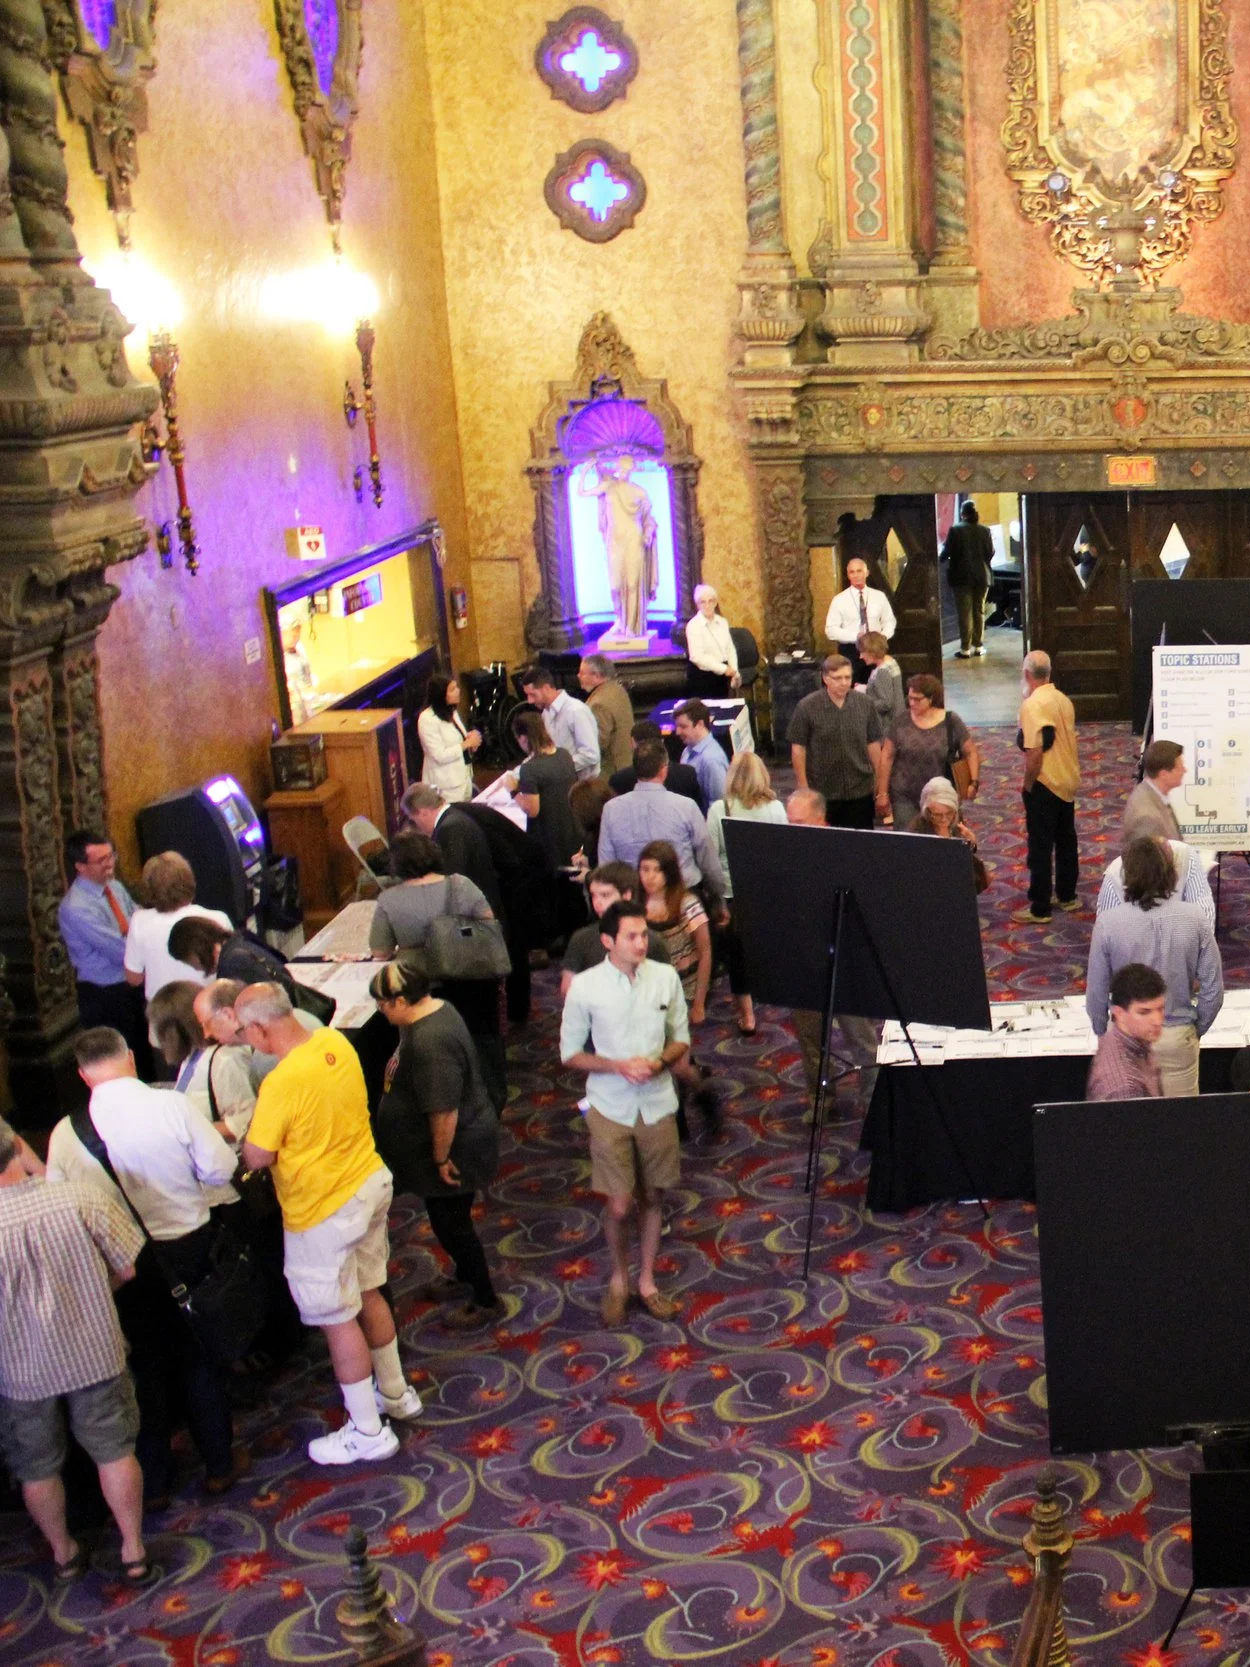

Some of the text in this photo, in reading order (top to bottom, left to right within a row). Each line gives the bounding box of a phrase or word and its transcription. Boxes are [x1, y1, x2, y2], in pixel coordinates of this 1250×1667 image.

[1112, 461, 1149, 481] EXIT
[1162, 654, 1238, 665] TOPIC STATIONS
[1185, 826, 1194, 834] TO
[1196, 825, 1218, 833] LEAVE
[1220, 825, 1246, 833] EARLY?
